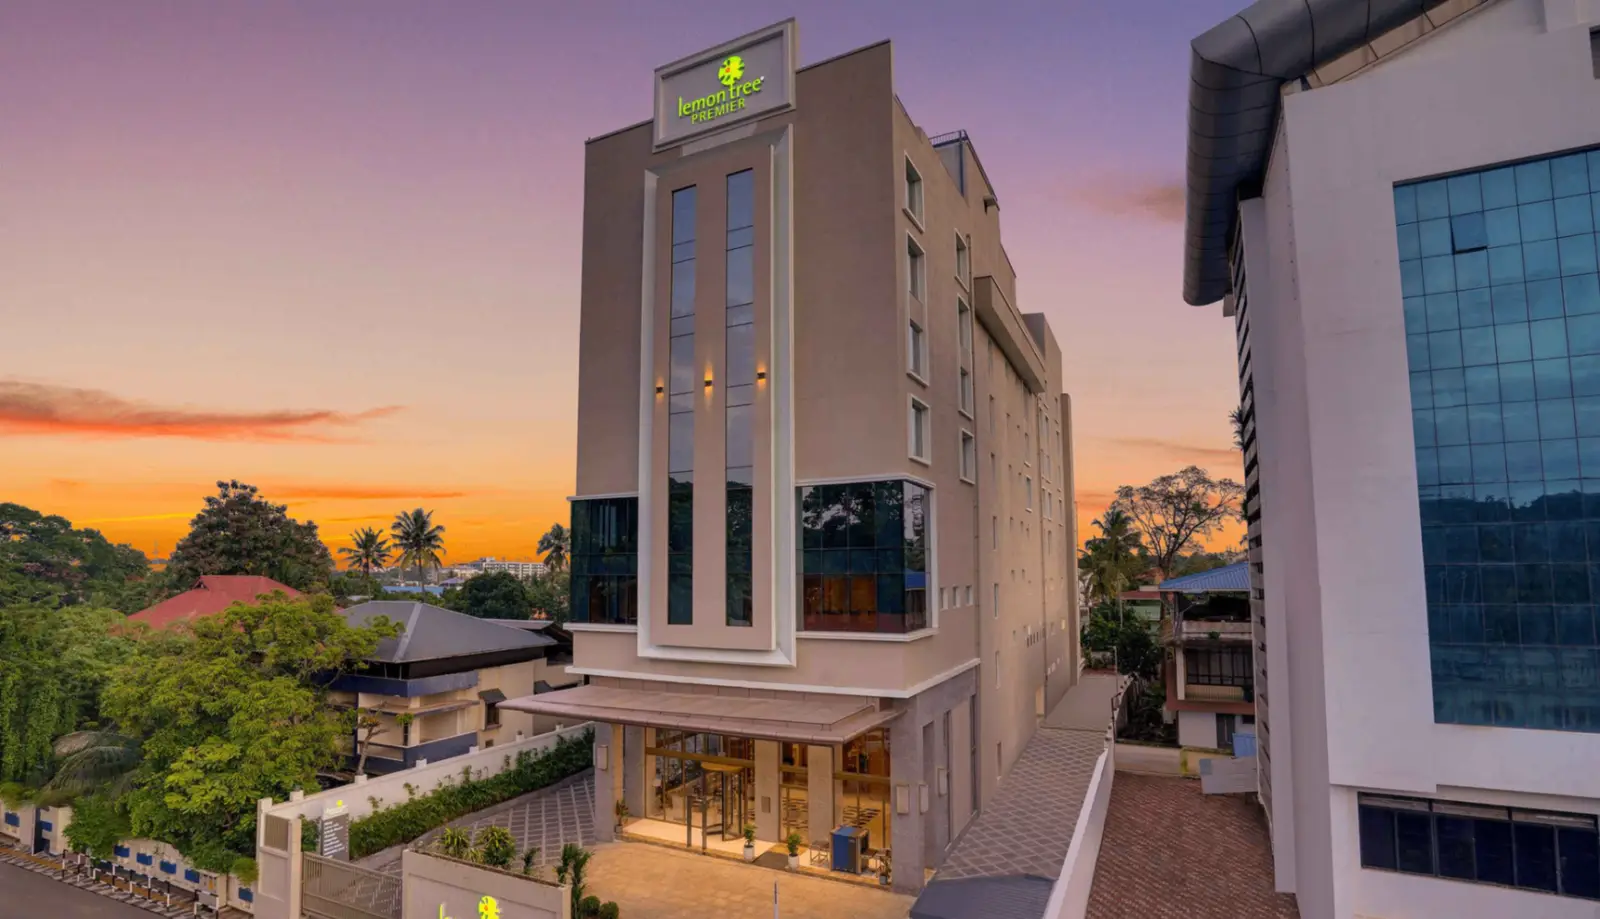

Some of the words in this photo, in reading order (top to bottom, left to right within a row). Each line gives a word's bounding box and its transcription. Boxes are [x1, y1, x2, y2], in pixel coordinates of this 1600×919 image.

[678, 90, 726, 117] lemon
[728, 78, 762, 99] tree
[691, 97, 745, 124] PREMIER
